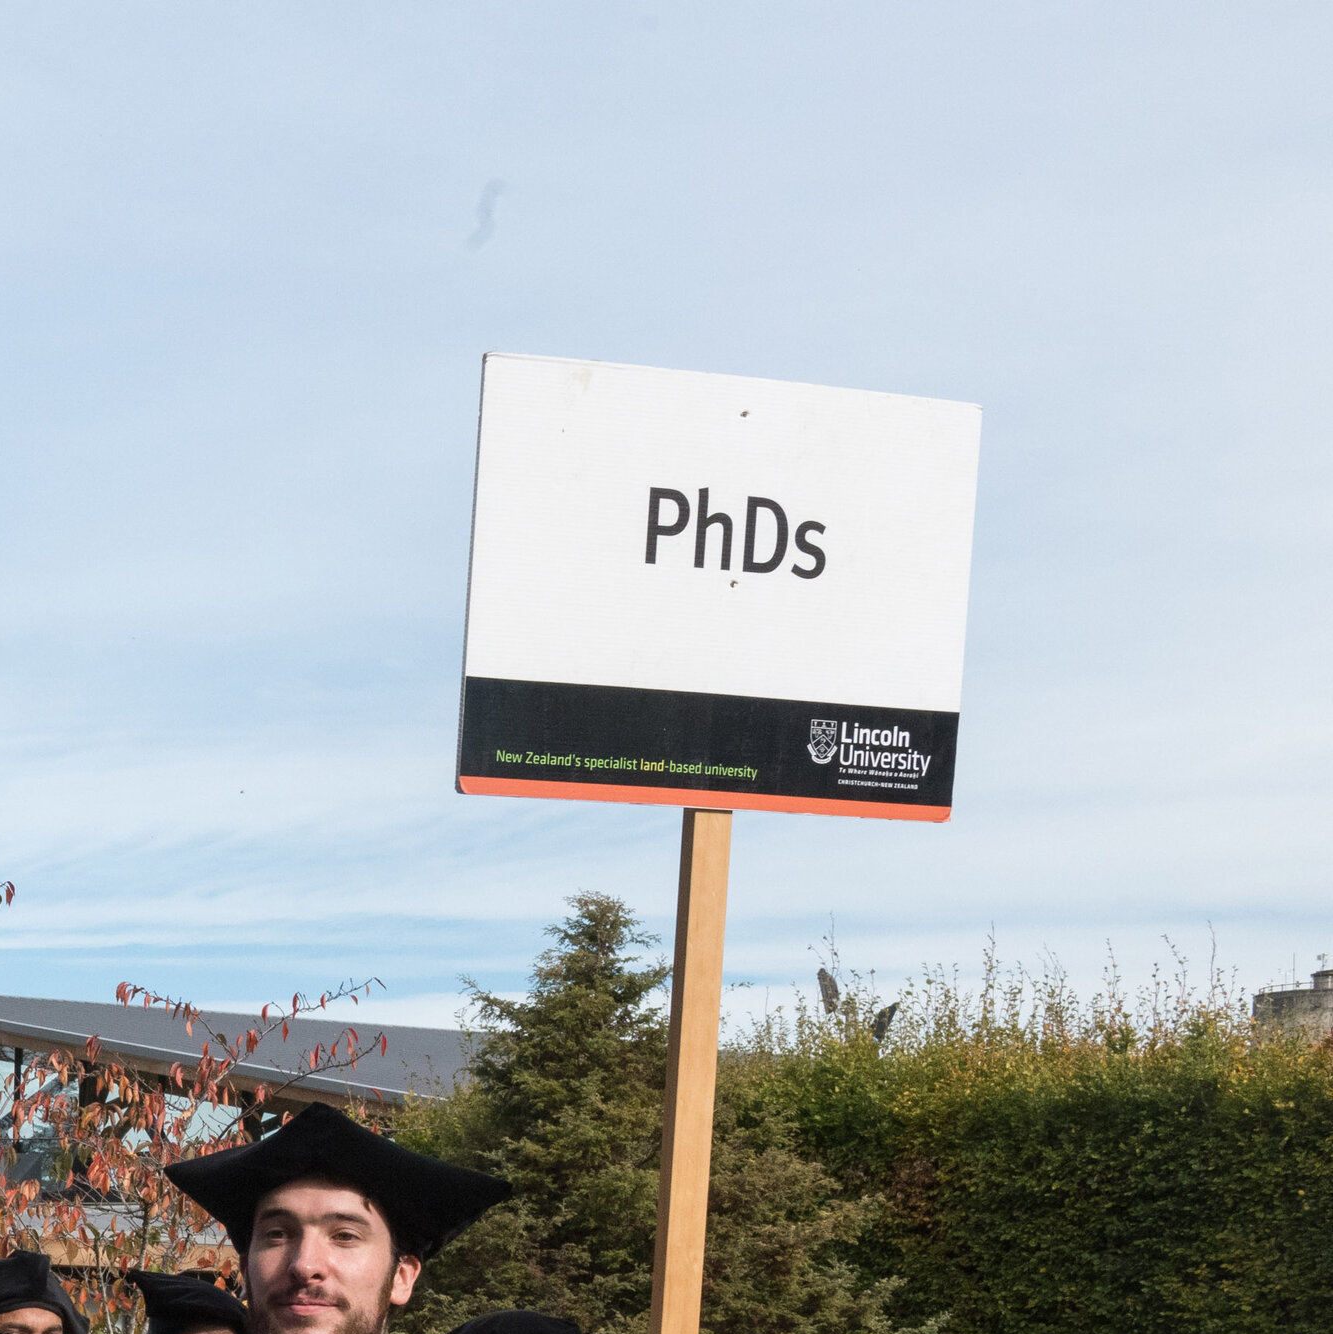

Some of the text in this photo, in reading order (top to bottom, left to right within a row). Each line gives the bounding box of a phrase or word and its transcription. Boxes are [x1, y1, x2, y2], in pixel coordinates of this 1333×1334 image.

[645, 487, 827, 580] PhDs
[841, 721, 910, 748] Lincoln
[496, 749, 758, 781] New Zealand's specialist land-based university
[839, 744, 932, 777] University
[894, 782, 919, 790] ZEALAND
